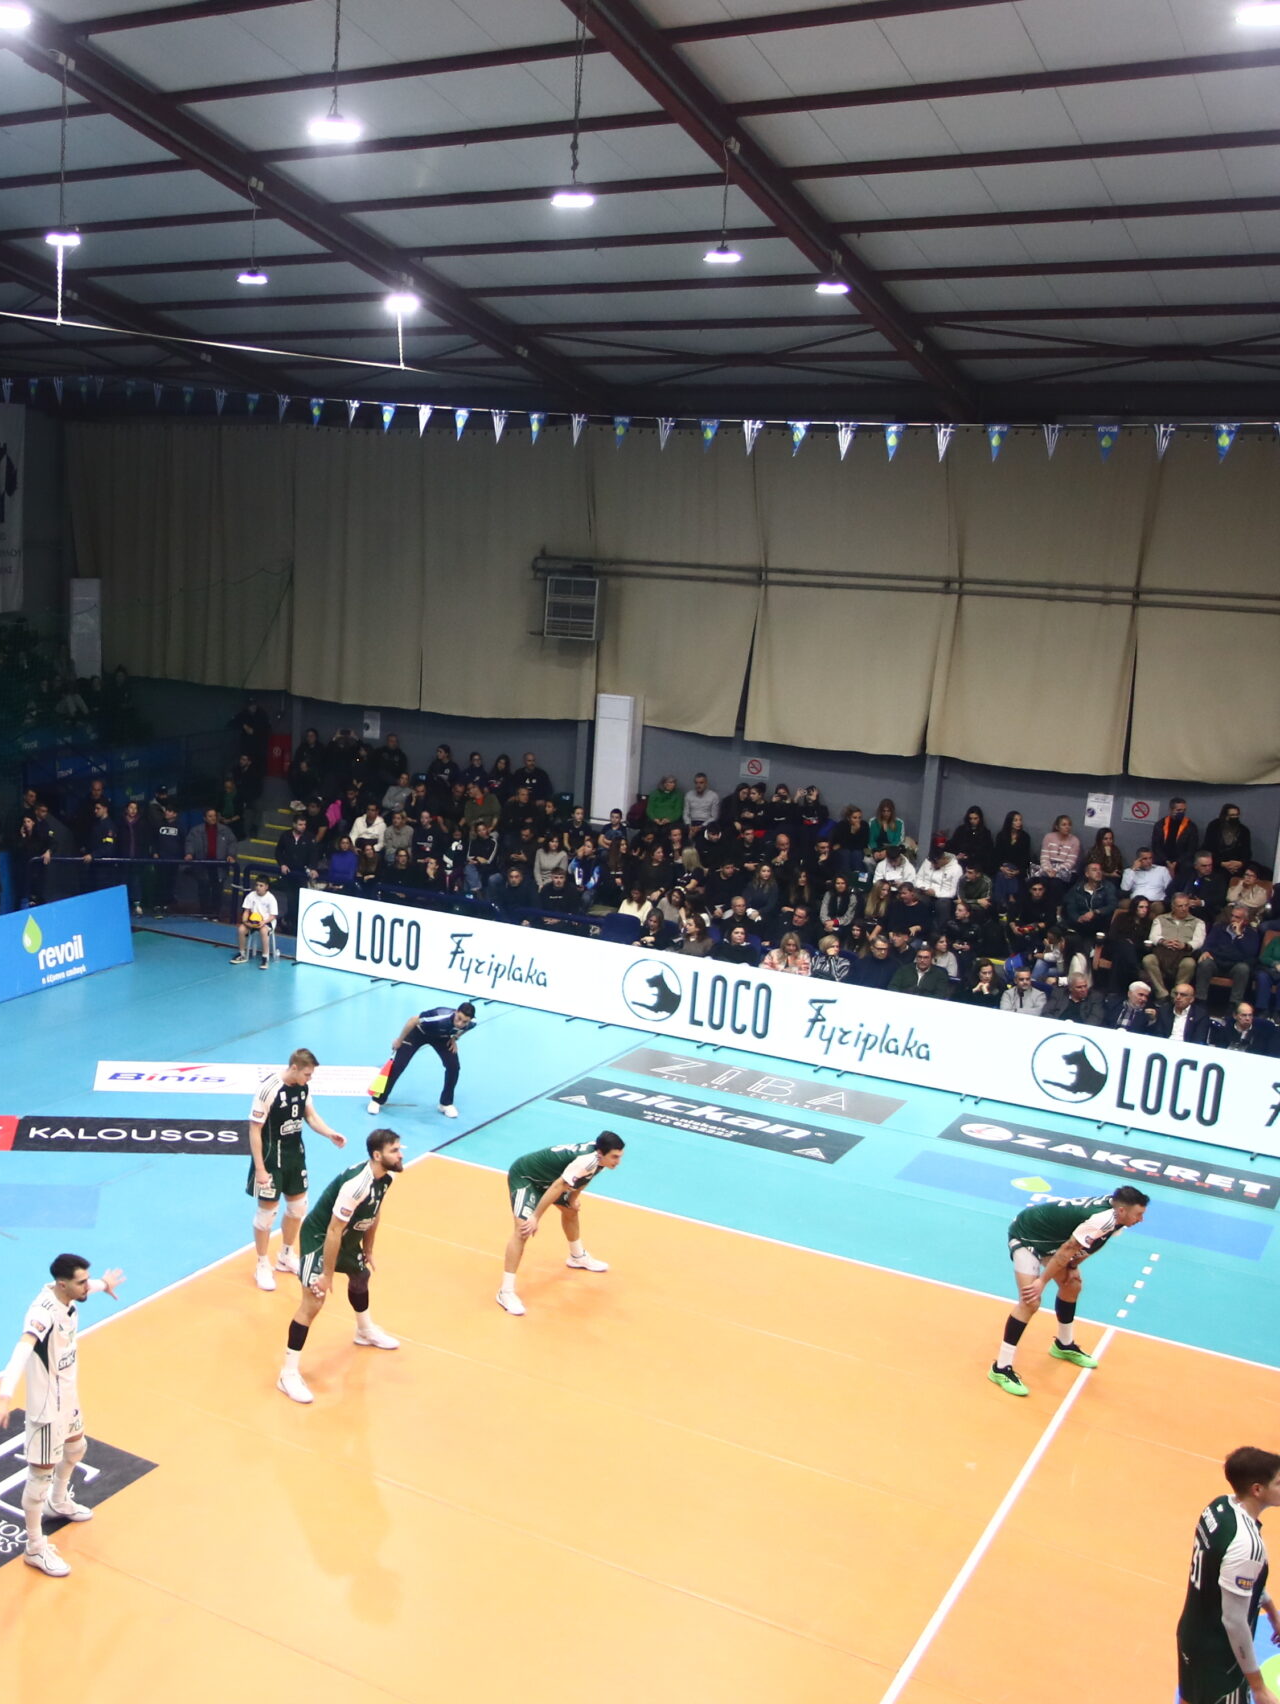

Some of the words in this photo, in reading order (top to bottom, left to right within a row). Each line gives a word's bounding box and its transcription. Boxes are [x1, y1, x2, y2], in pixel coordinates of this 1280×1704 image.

[37, 934, 84, 970] revoil
[355, 911, 420, 971] LOCO
[447, 932, 549, 988] Fyriplaka
[689, 971, 772, 1039] LOCO
[803, 998, 930, 1062] Fyriplaka
[108, 1070, 227, 1085] Binis
[1116, 1047, 1225, 1127] LOCO
[28, 1126, 239, 1144] KALOUSOS
[292, 1104, 298, 1117] 8
[598, 1087, 814, 1139] nickan
[1010, 1133, 1271, 1197] ZAKCRET
